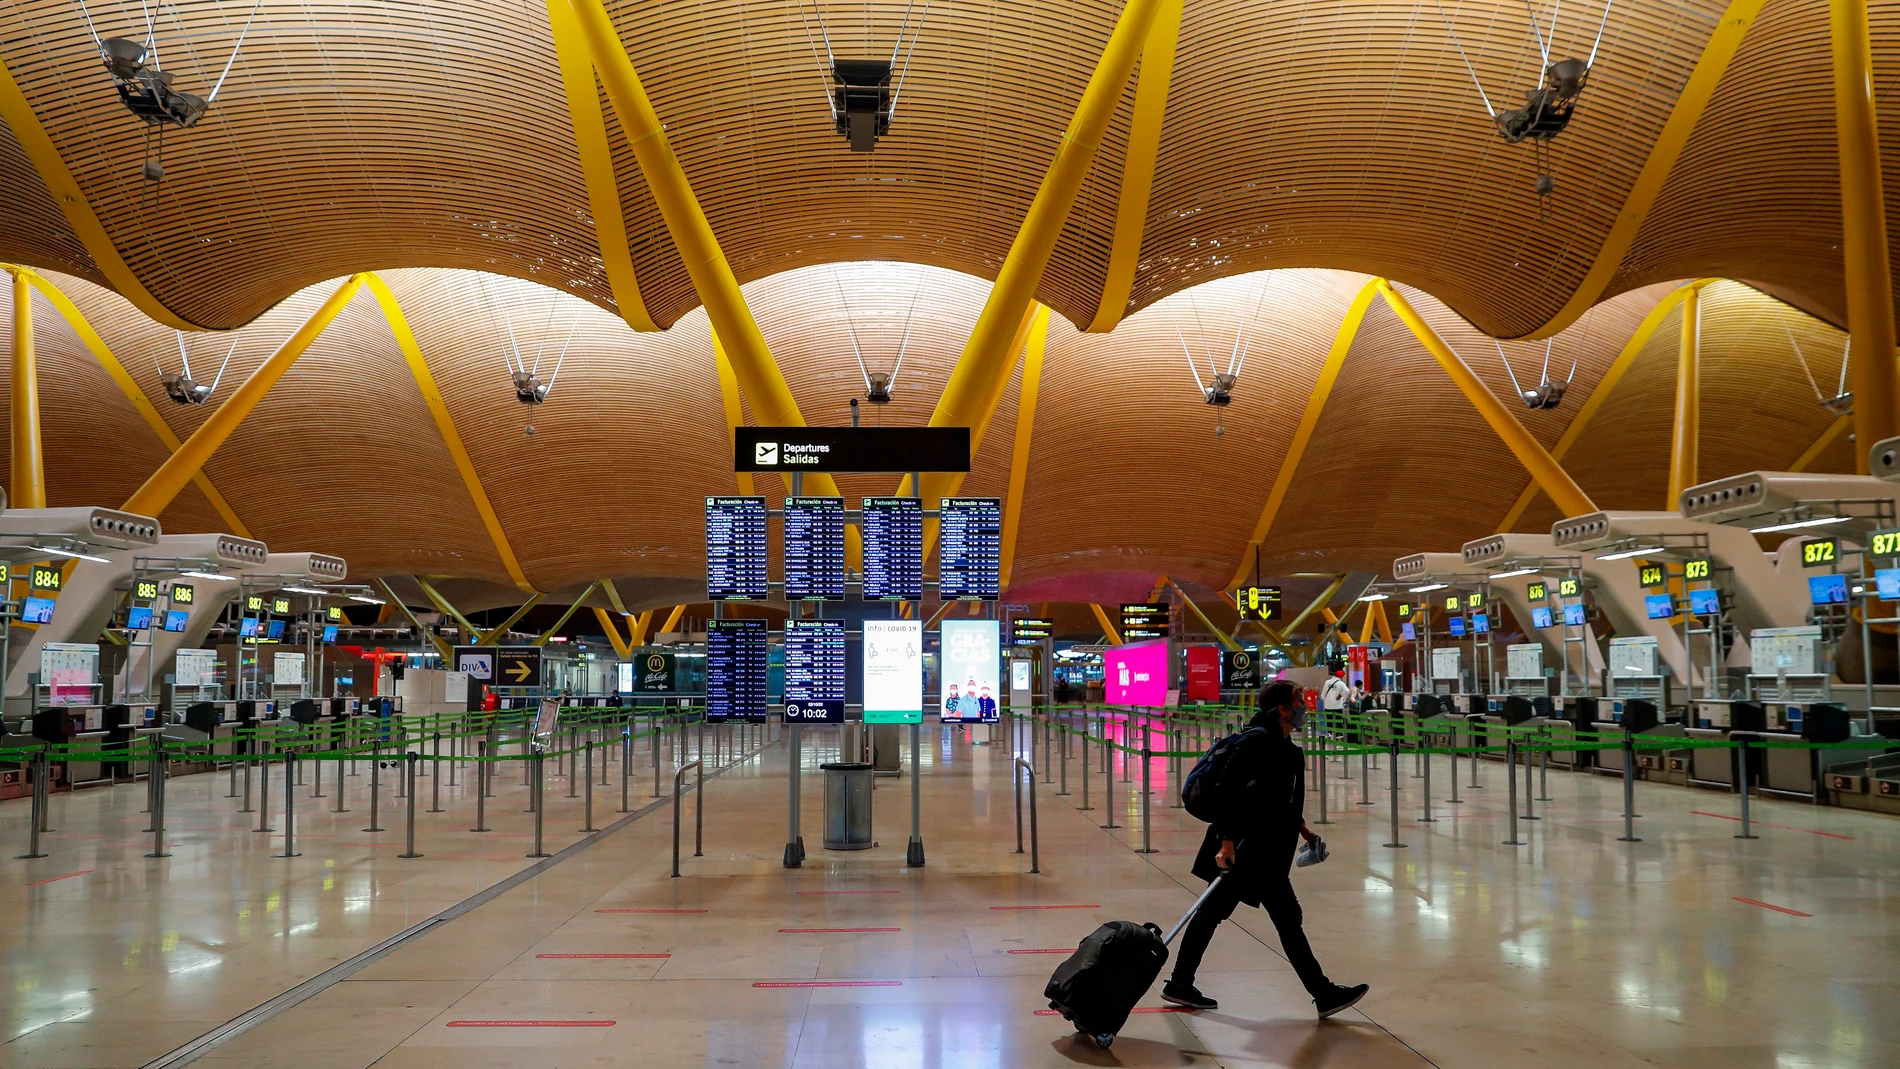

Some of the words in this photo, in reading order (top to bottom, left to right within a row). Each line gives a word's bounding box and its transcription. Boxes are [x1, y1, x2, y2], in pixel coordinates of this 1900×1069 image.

[783, 443, 830, 454] Departures
[783, 453, 819, 464] Salidas
[1872, 532, 1900, 554] 871
[1804, 541, 1834, 563] 872
[1642, 568, 1662, 584] 874
[1686, 560, 1708, 579] 873
[35, 570, 59, 587] 884
[137, 583, 157, 598] 885
[174, 587, 192, 602] 886
[1529, 586, 1543, 600] 876
[1560, 580, 1577, 596] 875
[248, 596, 262, 610] 887
[275, 600, 289, 613] 888
[1446, 598, 1458, 610] 878
[1469, 593, 1481, 607] 877
[329, 607, 341, 619] 889
[867, 624, 882, 632] info
[950, 633, 991, 648] GRA-
[950, 648, 991, 662] CIAS
[802, 708, 827, 718] 10:02
